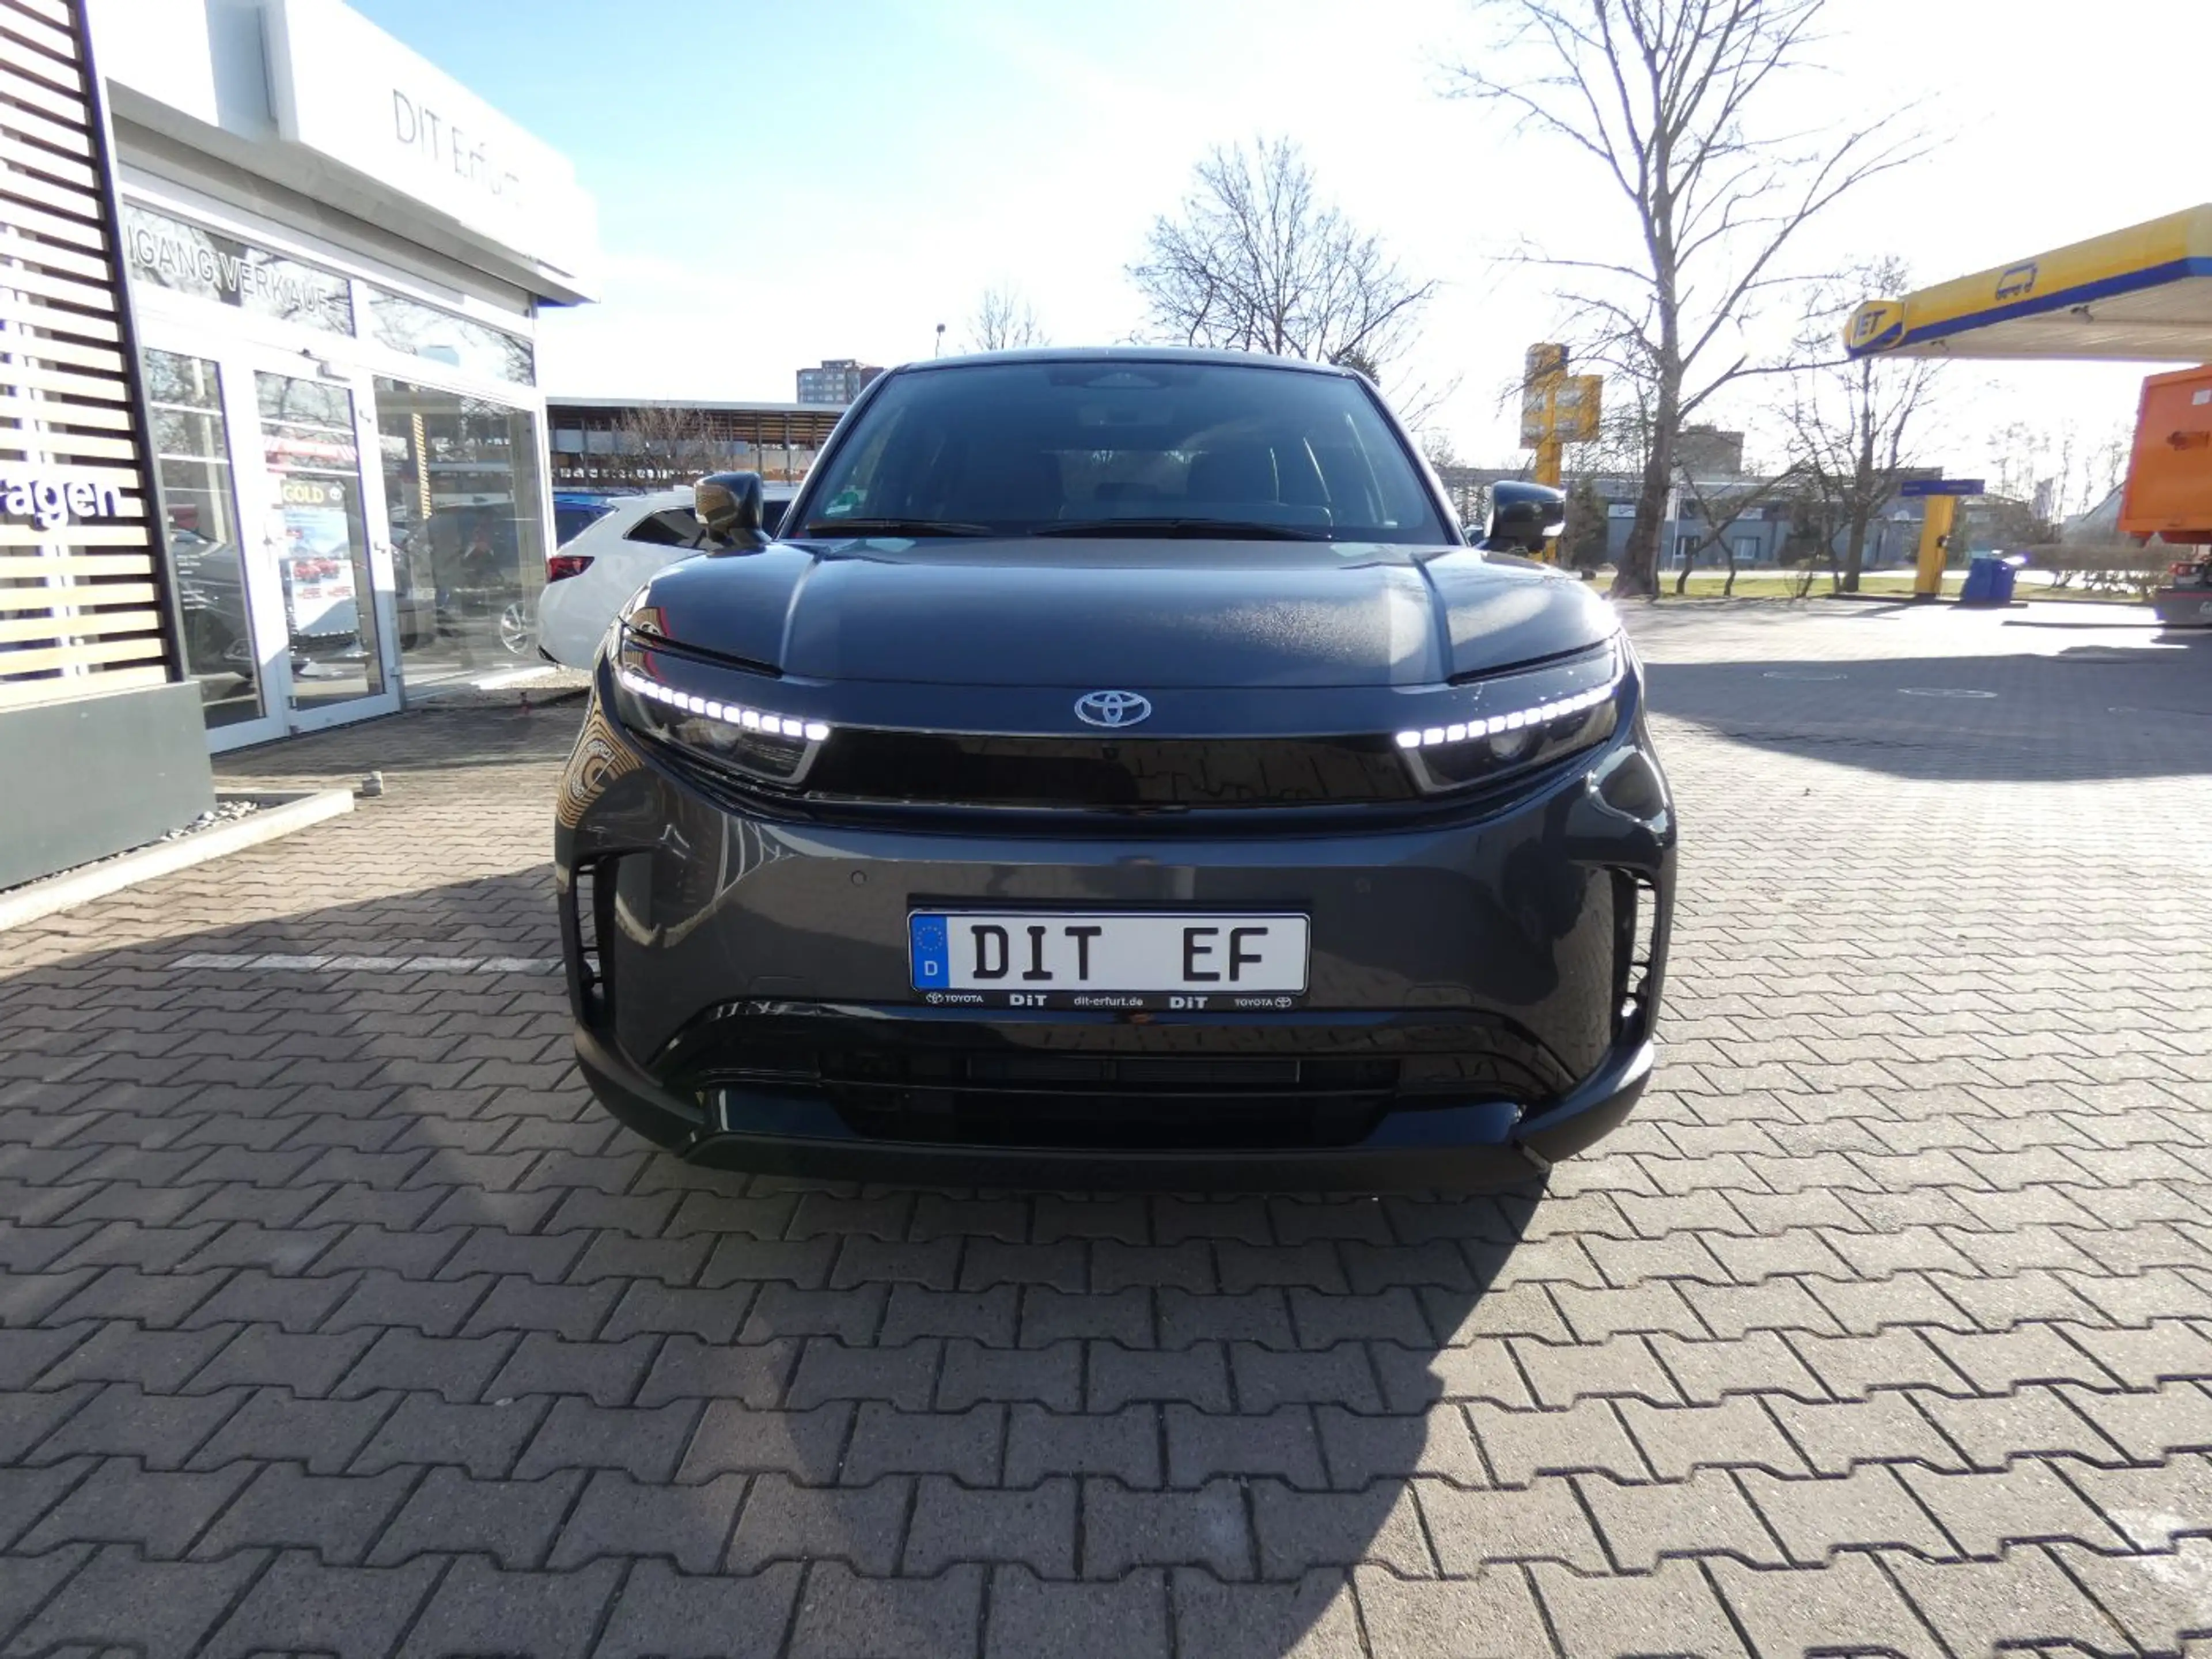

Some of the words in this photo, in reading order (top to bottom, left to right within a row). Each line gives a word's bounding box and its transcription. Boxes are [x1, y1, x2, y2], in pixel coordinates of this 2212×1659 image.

[392, 88, 441, 163] DIT
[218, 250, 328, 315] VERKAUF
[924, 960, 938, 976] D
[971, 925, 1102, 980] DIT
[1183, 927, 1268, 982] EF
[1074, 996, 1143, 1006] dit-erfurt.de
[1234, 998, 1273, 1006] TOYOTA
